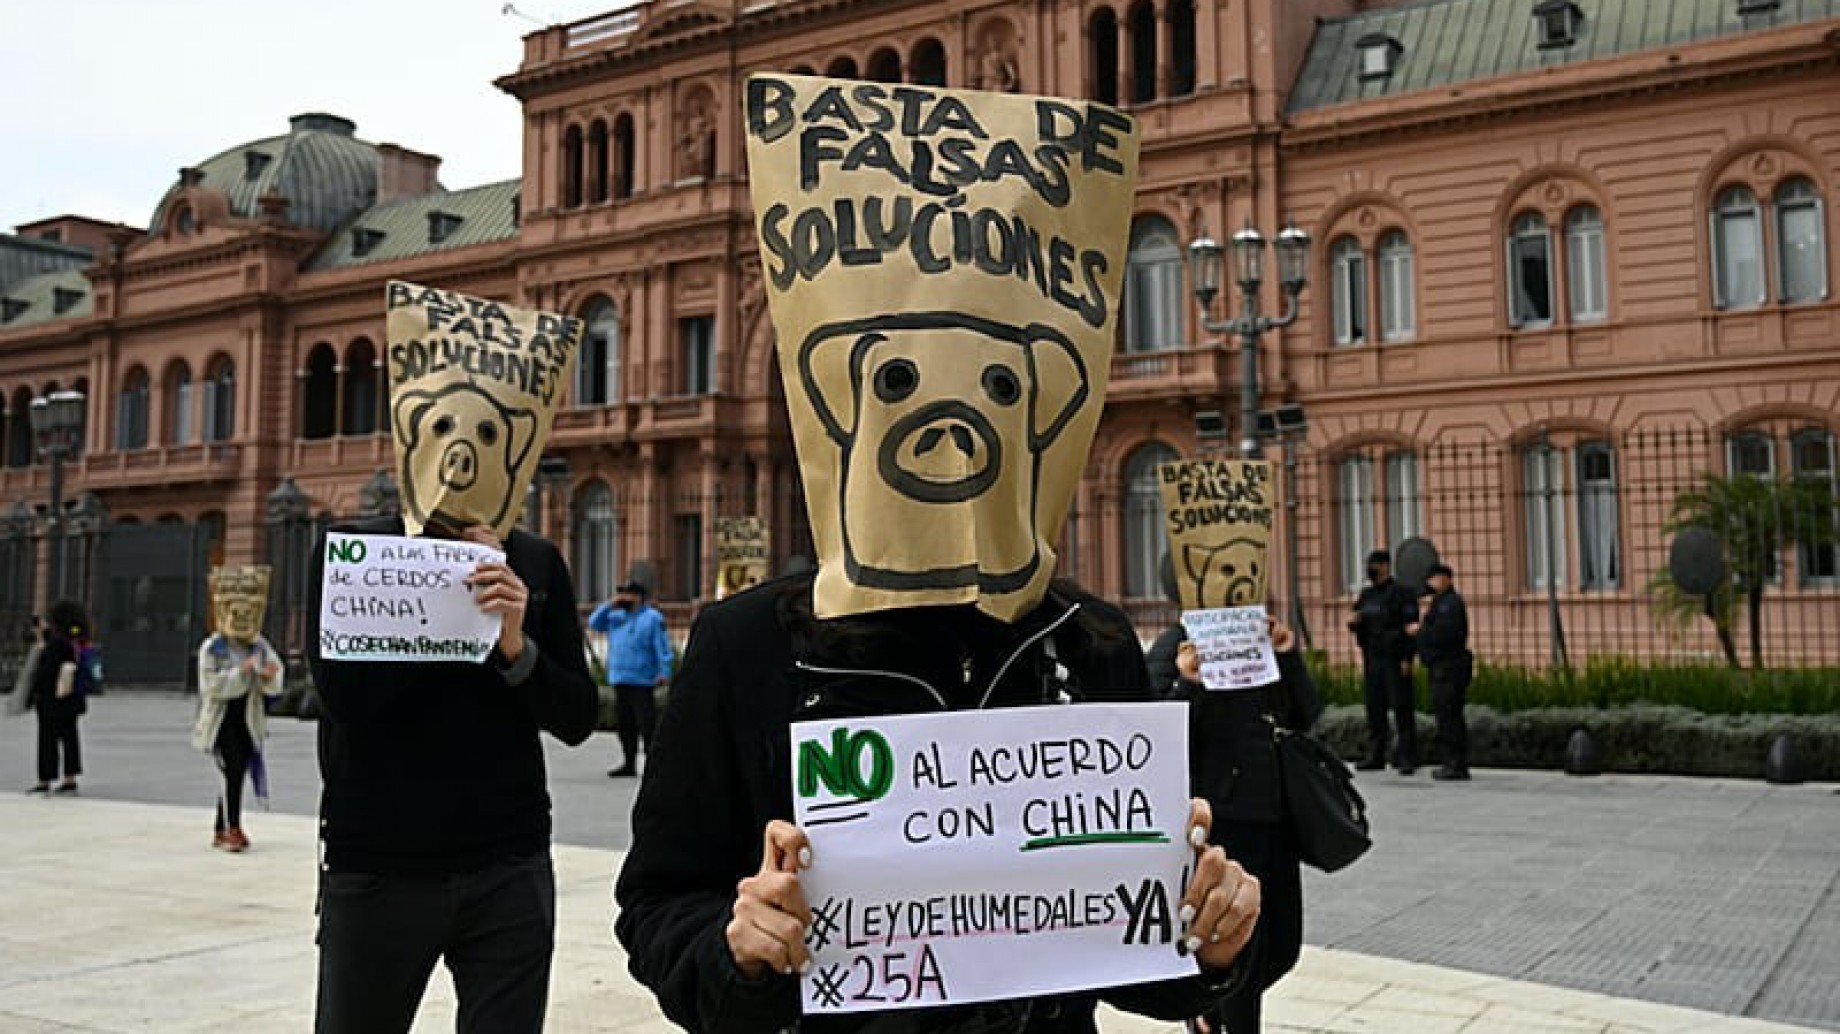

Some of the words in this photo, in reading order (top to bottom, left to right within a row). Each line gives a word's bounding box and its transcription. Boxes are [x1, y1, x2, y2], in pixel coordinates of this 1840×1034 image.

[747, 77, 989, 144] BASTA
[1036, 101, 1132, 176] DE
[801, 126, 1071, 208] FALSAS
[389, 282, 514, 326] BASTA
[537, 314, 580, 345] DE
[427, 304, 566, 366] FALSAS
[1163, 461, 1231, 484] BASTA
[1178, 481, 1263, 505] FALSAS
[328, 538, 367, 564] NO
[362, 568, 451, 588] CERDOS
[798, 727, 894, 800] NO
[912, 741, 957, 789] AL
[969, 733, 1152, 785] ACUERDO
[903, 803, 995, 844] CON
[811, 944, 948, 1008] #25A
